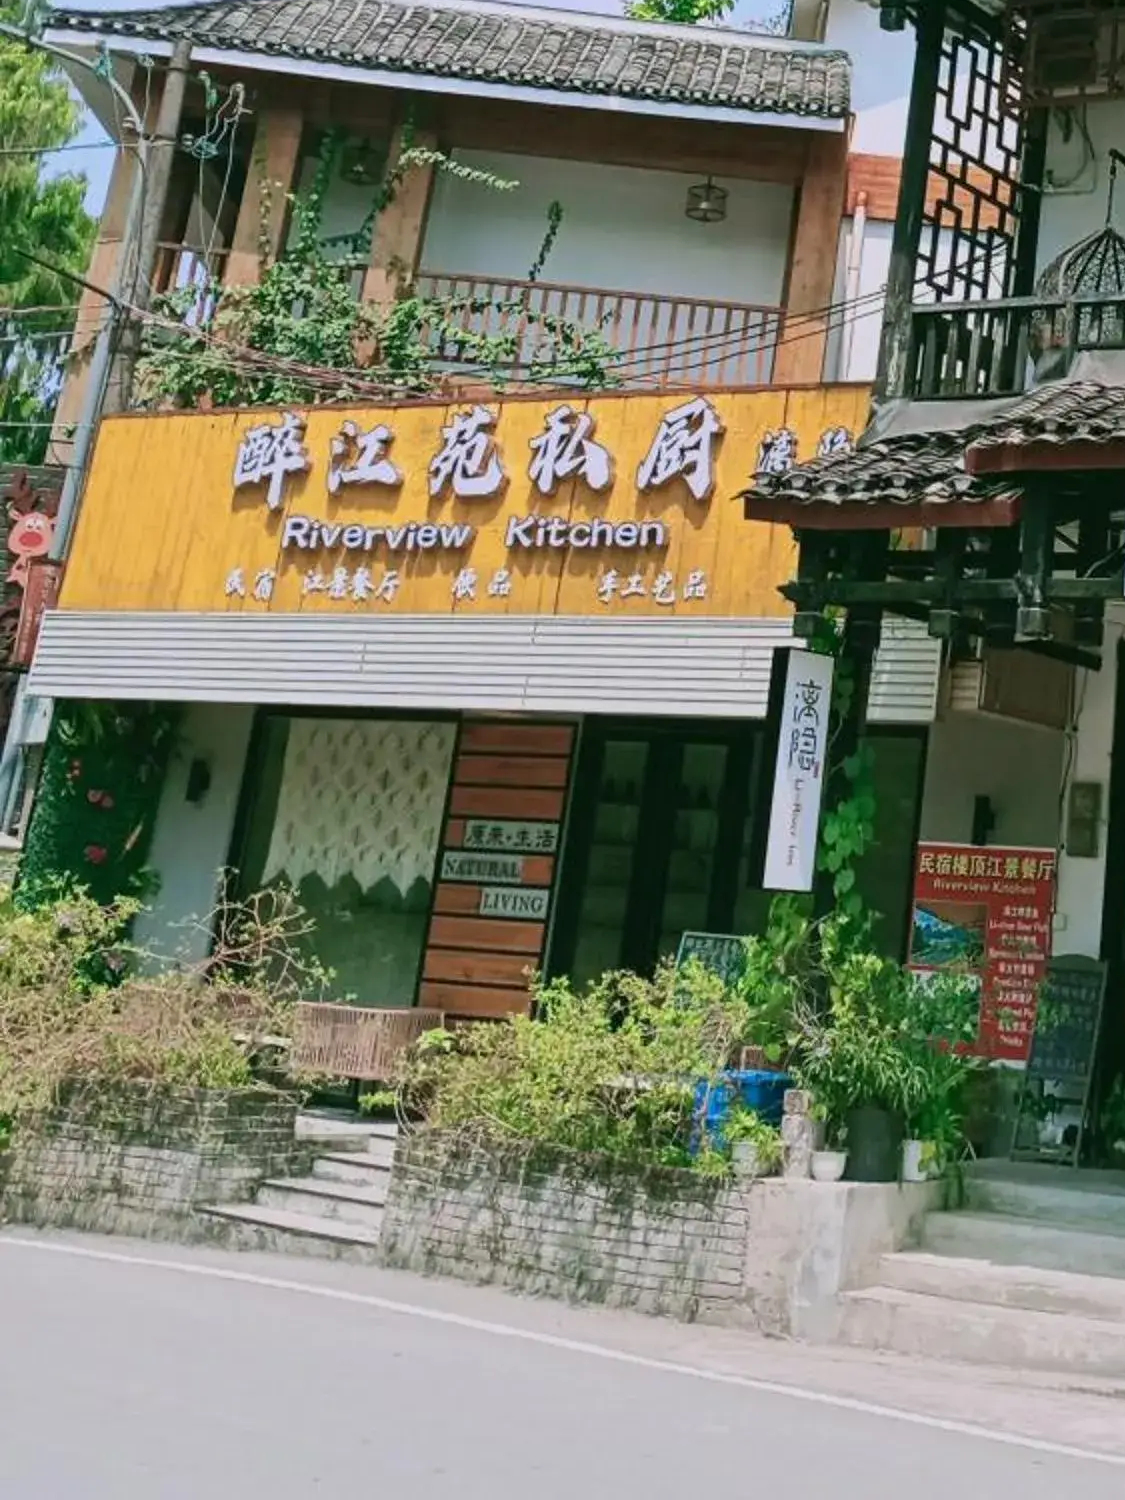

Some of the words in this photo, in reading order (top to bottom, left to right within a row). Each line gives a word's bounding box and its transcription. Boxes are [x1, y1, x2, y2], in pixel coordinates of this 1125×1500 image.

[232, 396, 722, 510] 醉江苑私厨
[281, 515, 471, 550] Riverview
[505, 514, 666, 548] Kitchen
[596, 568, 708, 604] 手工艺品
[443, 858, 521, 879] NATURAL
[919, 853, 1055, 880] 民宿楼顶江景餐厅
[483, 893, 545, 915] LIVING
